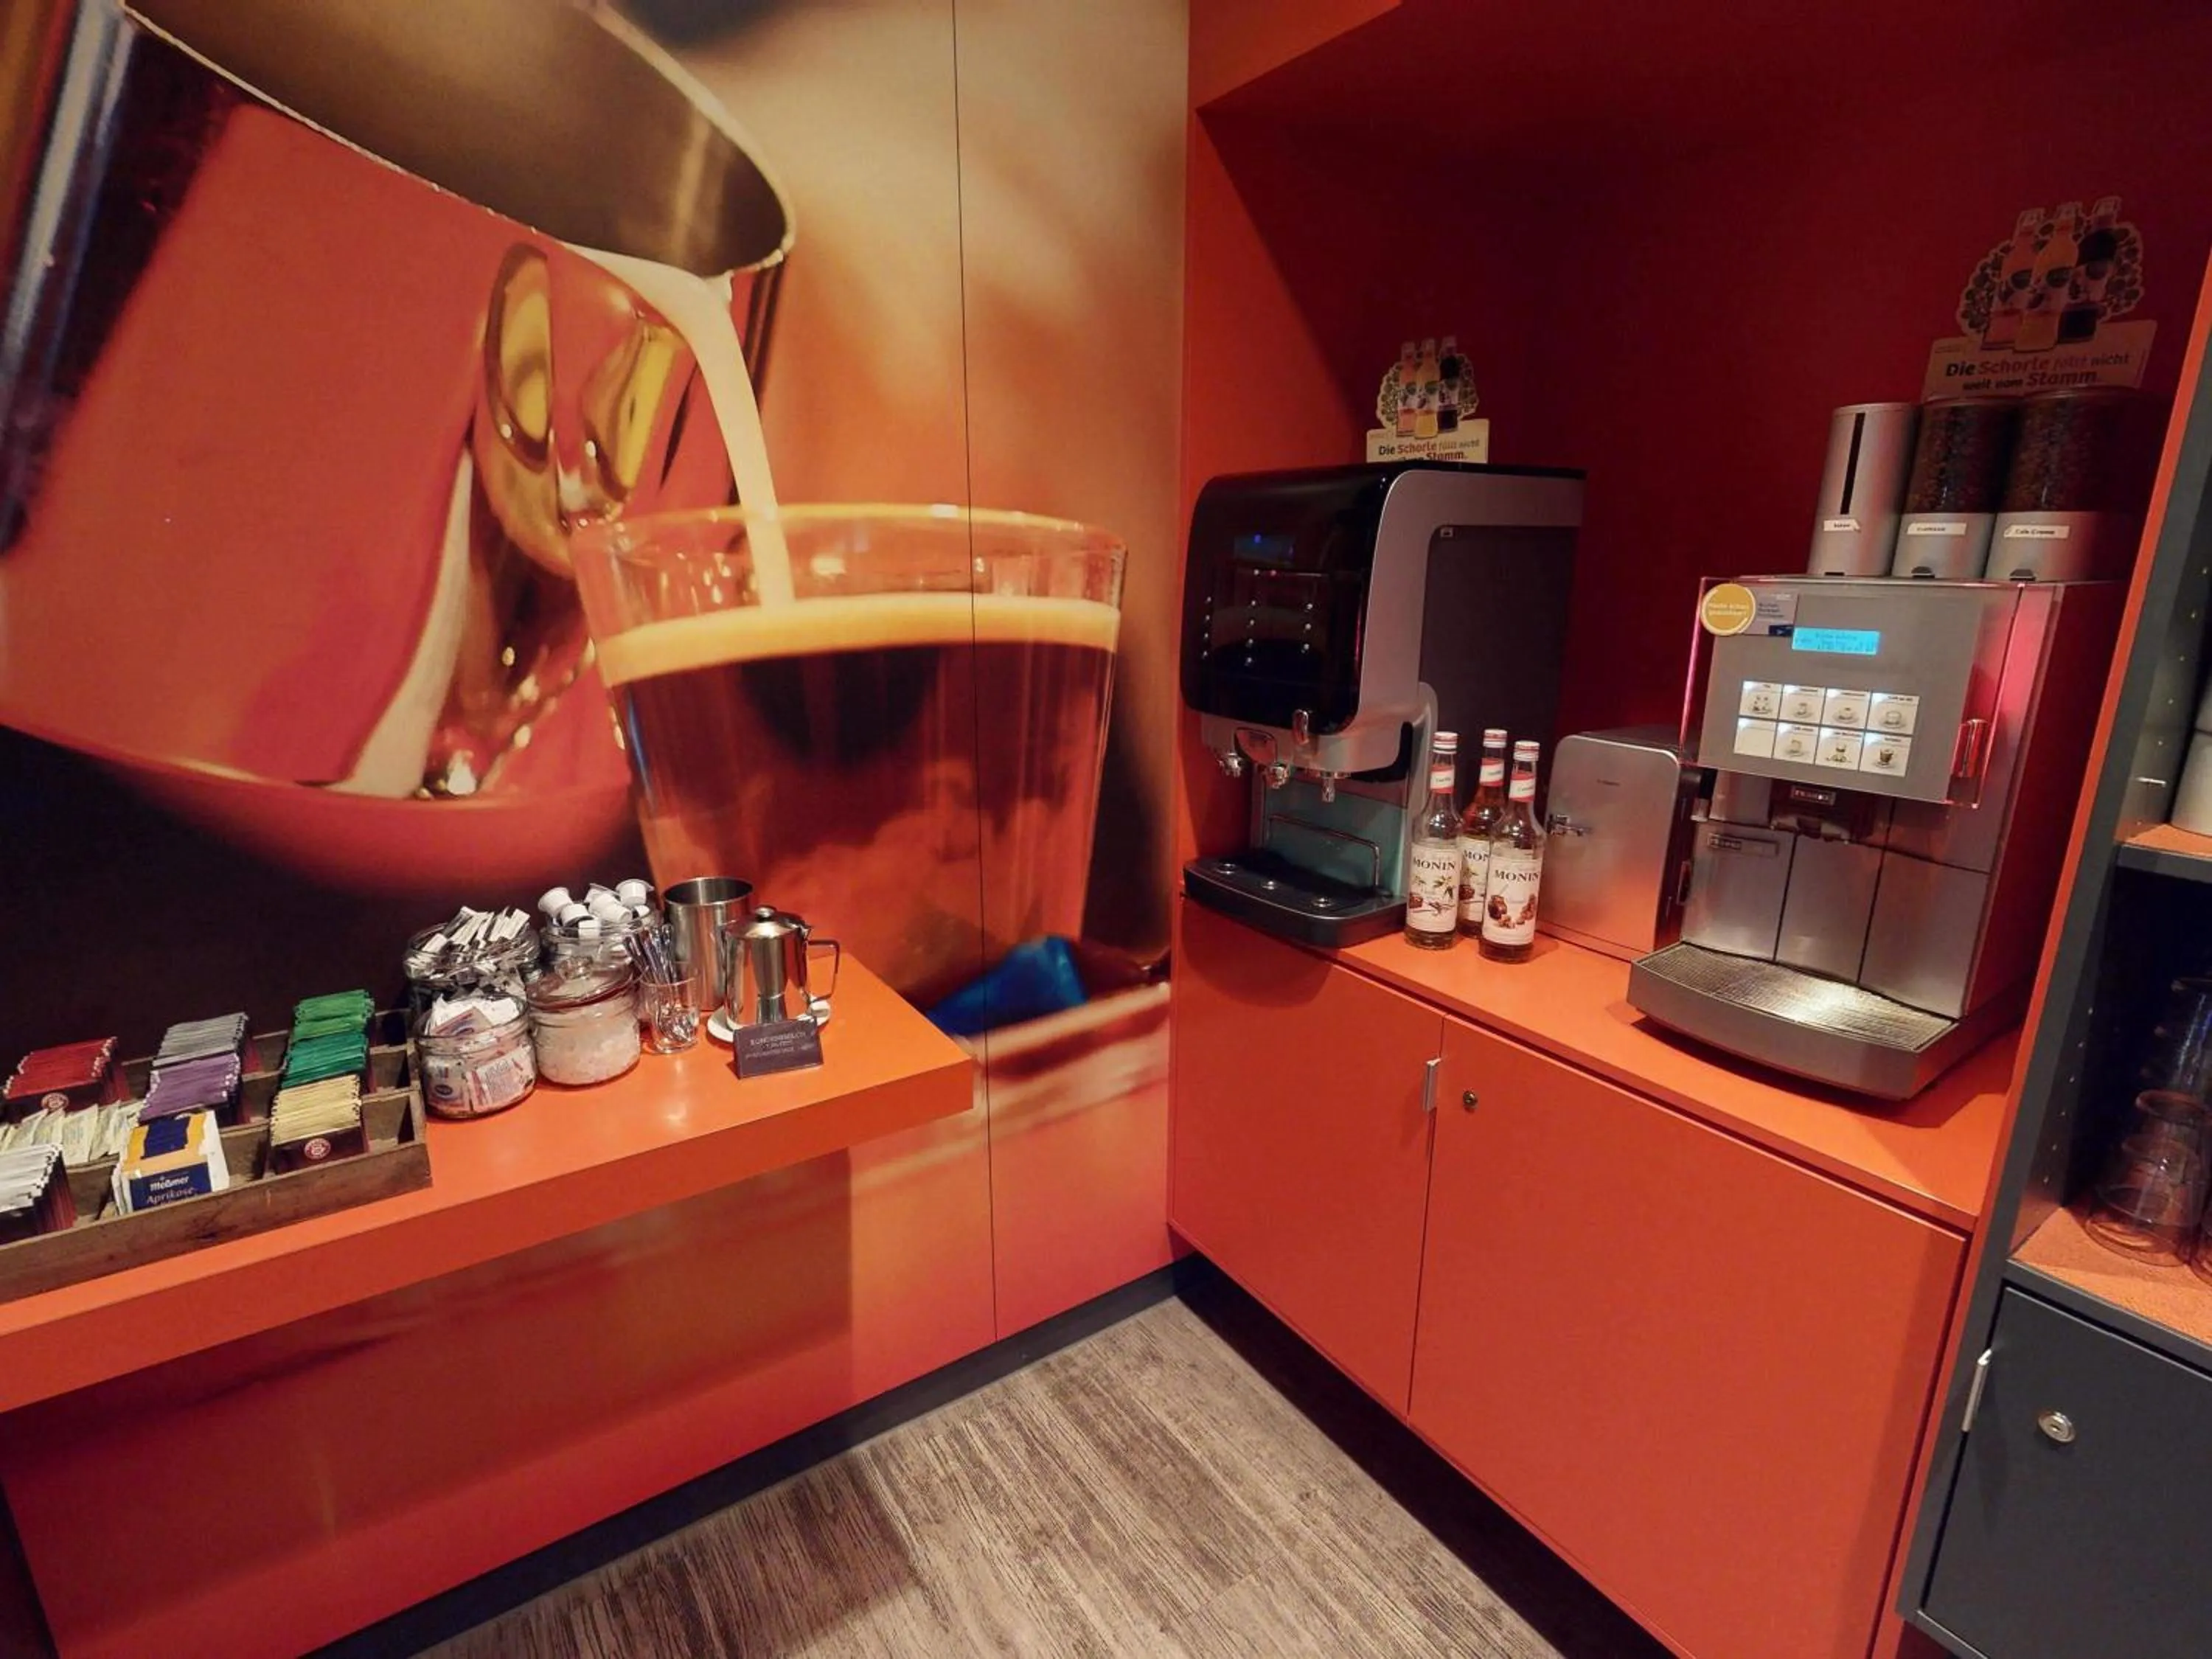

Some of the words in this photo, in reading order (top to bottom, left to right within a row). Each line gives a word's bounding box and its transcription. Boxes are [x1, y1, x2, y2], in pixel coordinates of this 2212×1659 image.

[1945, 361, 1976, 377] Die
[1379, 445, 1396, 455] Die
[1397, 440, 1437, 455] Schorle
[1464, 849, 1489, 863] MON
[1413, 857, 1455, 871] MONIN
[1495, 869, 1539, 881] MONIN
